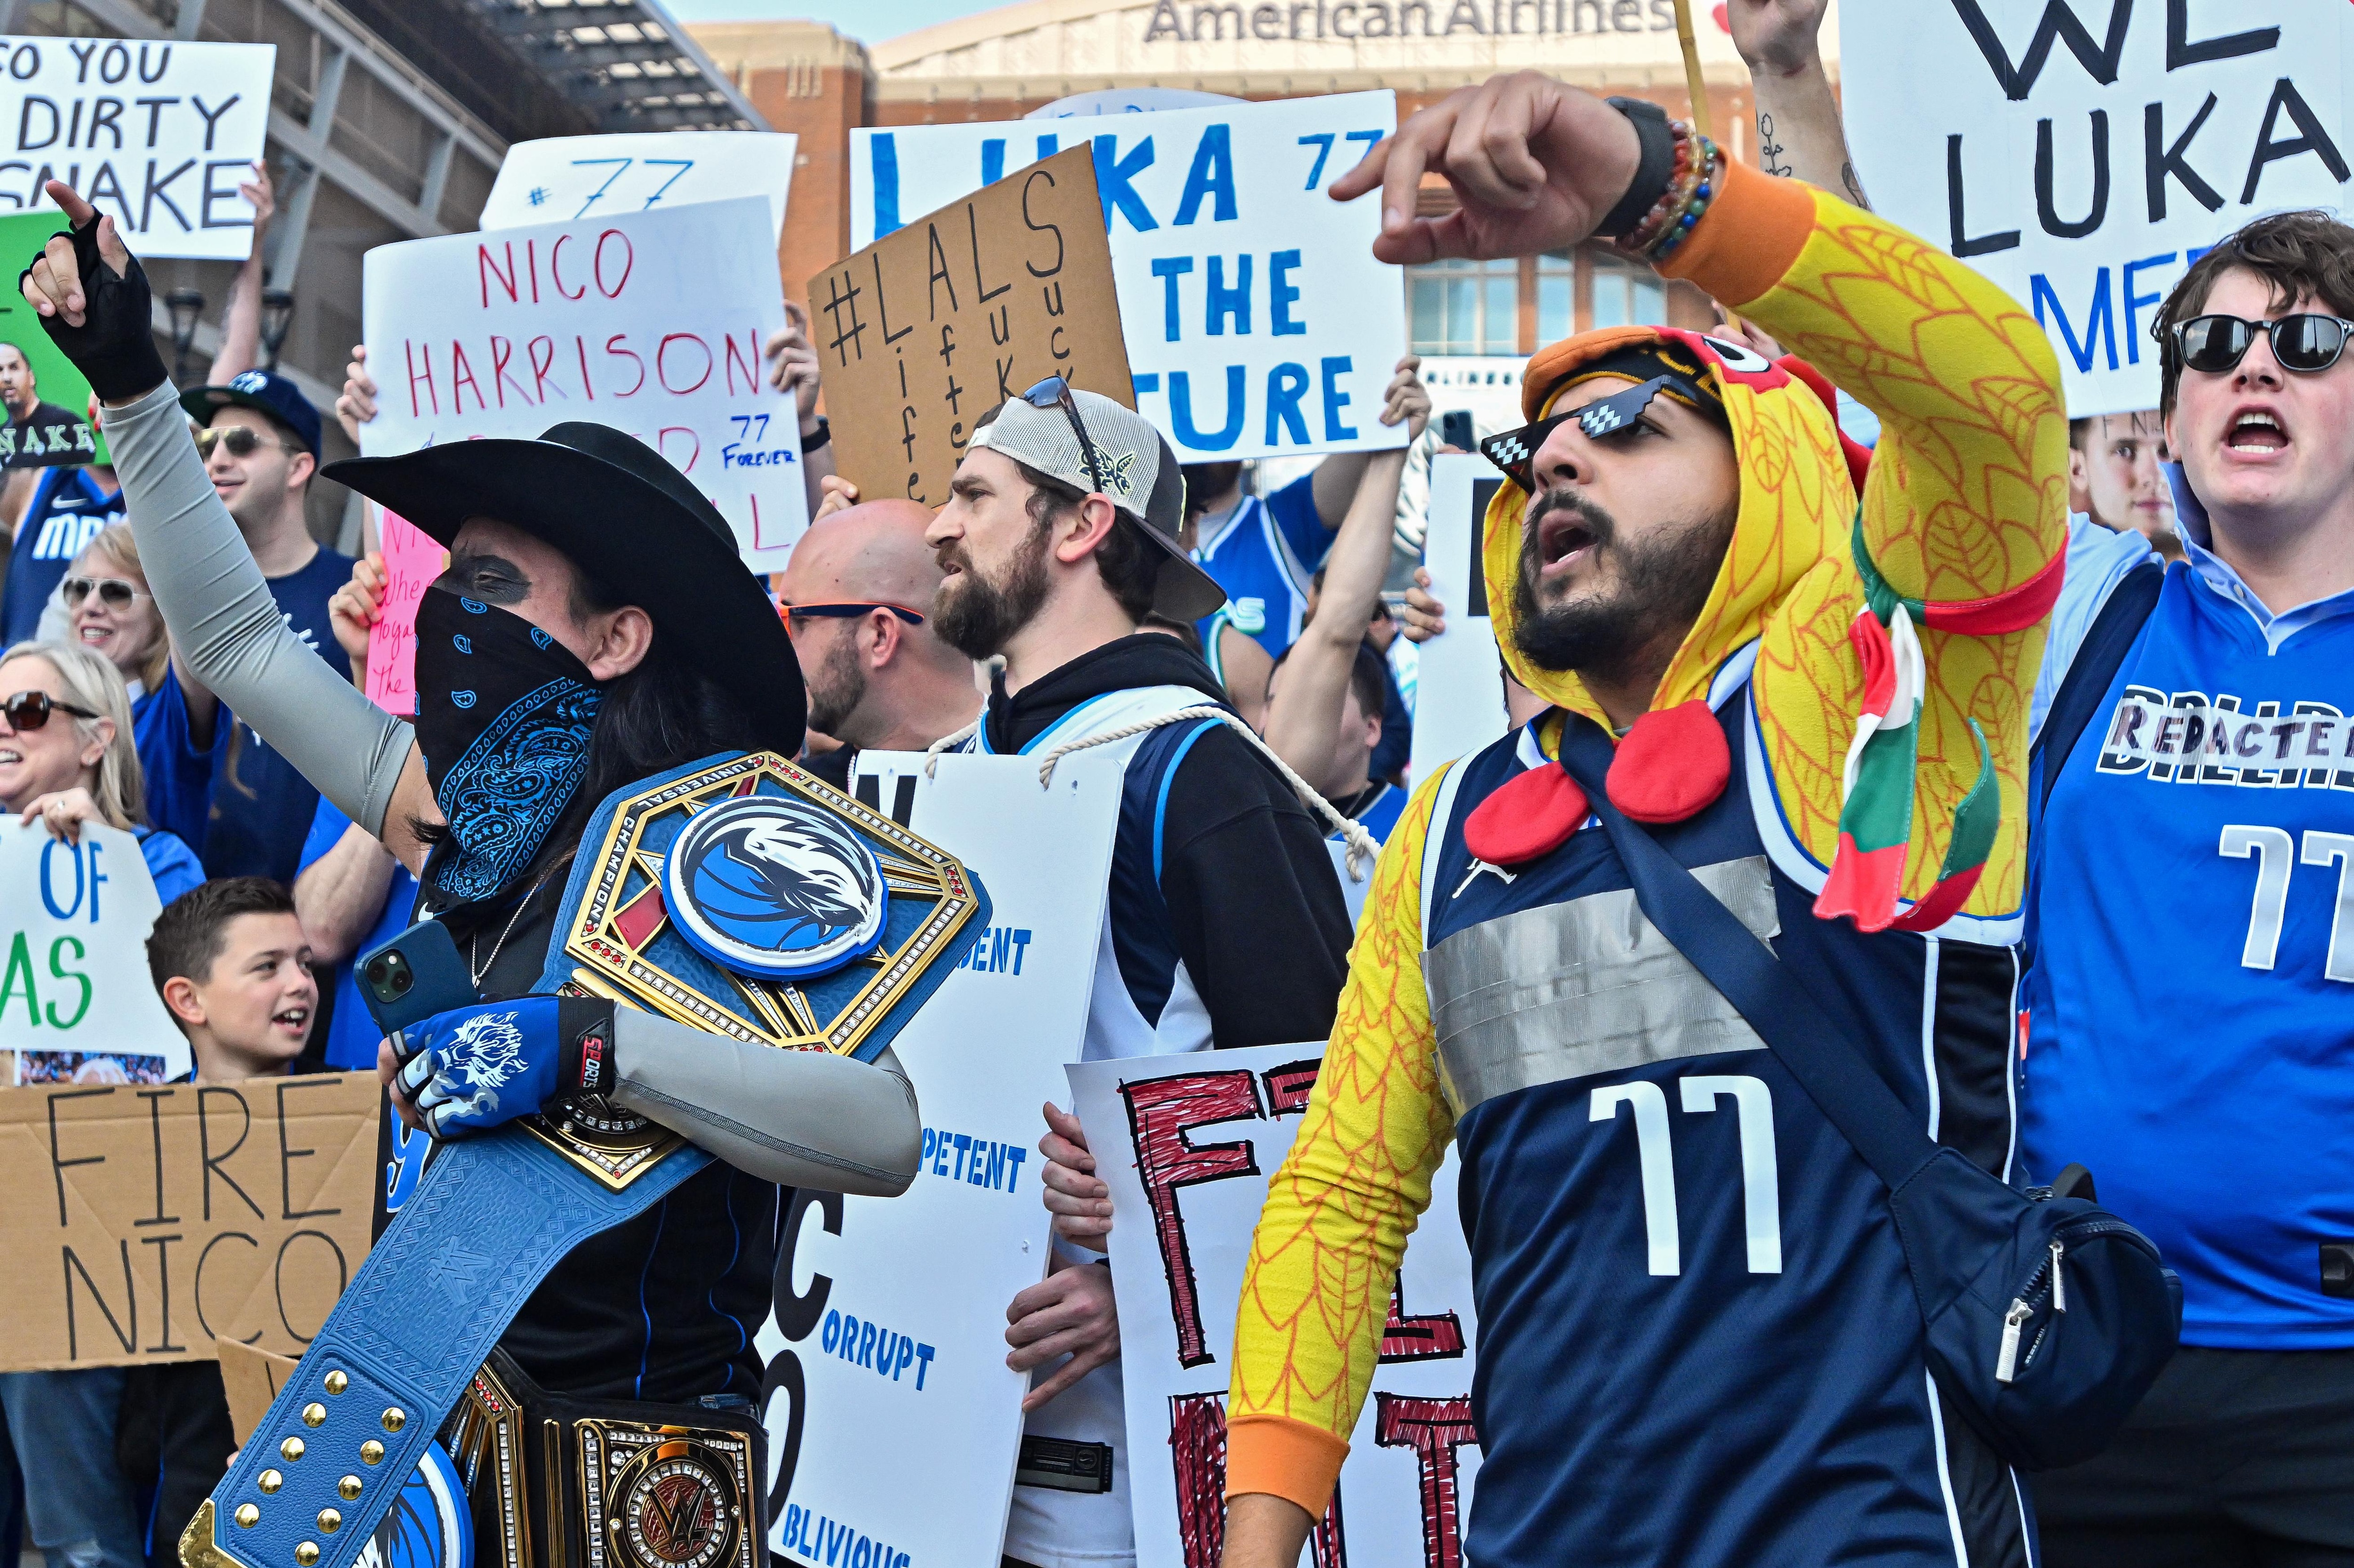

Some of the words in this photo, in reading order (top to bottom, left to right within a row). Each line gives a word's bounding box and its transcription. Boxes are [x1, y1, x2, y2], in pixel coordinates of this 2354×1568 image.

[0, 41, 40, 80] O
[69, 43, 171, 84] YOU
[17, 95, 239, 151] DIRTY
[1947, 77, 2352, 257] LUKA
[870, 123, 1239, 241] LKA
[477, 228, 633, 308] NICO
[823, 170, 1064, 367] #LALS
[1151, 249, 1307, 342] THE
[2030, 245, 2217, 374] MF
[405, 328, 760, 418] HARRISON
[731, 412, 770, 442] 77
[373, 664, 408, 700] The
[637, 764, 748, 808] UNIVERSAL
[39, 836, 108, 923] OF
[589, 816, 636, 920] CHAMPION
[2218, 824, 2354, 984] 77
[580, 1036, 604, 1089] SPORTS
[48, 1078, 343, 1228] FIRE
[1588, 1075, 1782, 1276] 77
[62, 1229, 347, 1361] NICO
